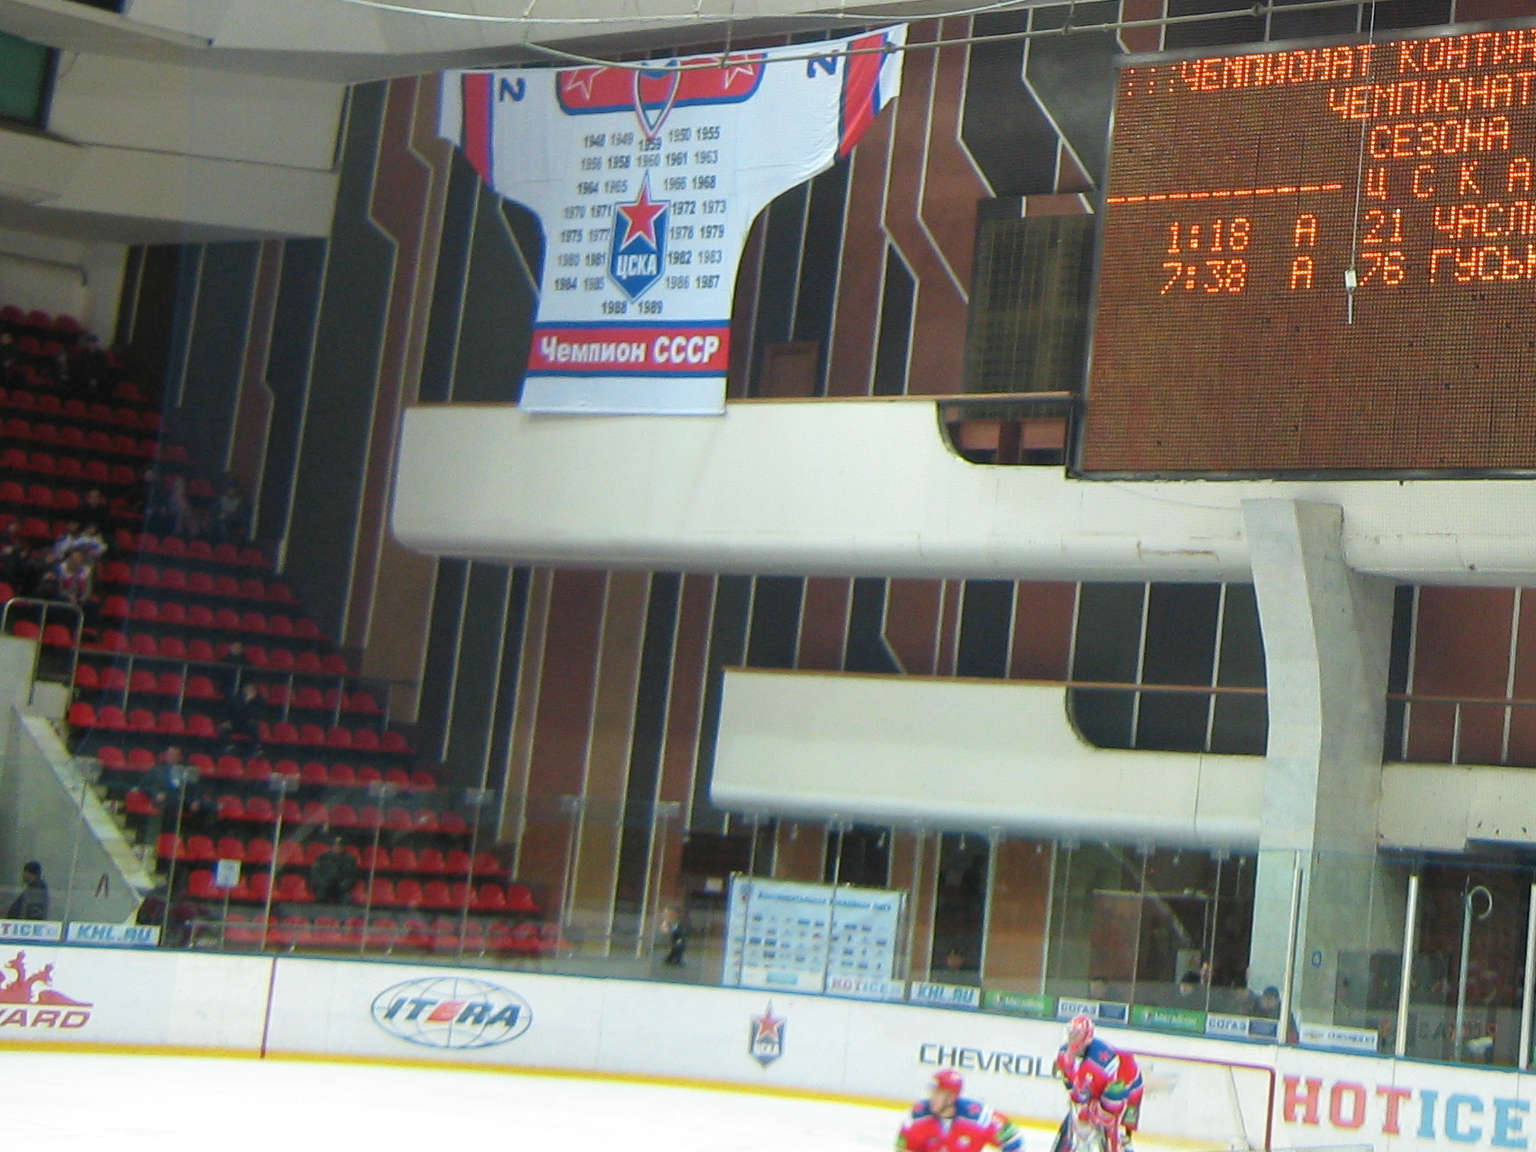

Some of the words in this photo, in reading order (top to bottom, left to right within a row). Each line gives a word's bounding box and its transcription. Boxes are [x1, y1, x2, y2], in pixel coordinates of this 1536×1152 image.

[1181, 44, 1376, 91] ЧЕМПИОНАТ
[1329, 71, 1536, 119] ЧЕМПИОНАТ
[696, 125, 721, 141] 1955
[1369, 115, 1511, 160] СЕЗОНА
[665, 151, 688, 166] 1961
[589, 204, 612, 219] 1971
[672, 201, 697, 215] 1972
[702, 200, 727, 215] 1973
[588, 228, 610, 242] 1977
[700, 224, 725, 239] 1979
[1167, 216, 1252, 255] 1:18
[1362, 208, 1403, 245] 21
[616, 254, 658, 280] ЦСКА
[1160, 258, 1248, 296] 7:38
[1357, 250, 1406, 287] 76
[540, 336, 646, 364] Чемпион
[653, 336, 720, 364] СССР
[77, 924, 153, 941] KHL.RU
[384, 996, 522, 1027] ITERA
[920, 1043, 1062, 1079] CHEVROL
